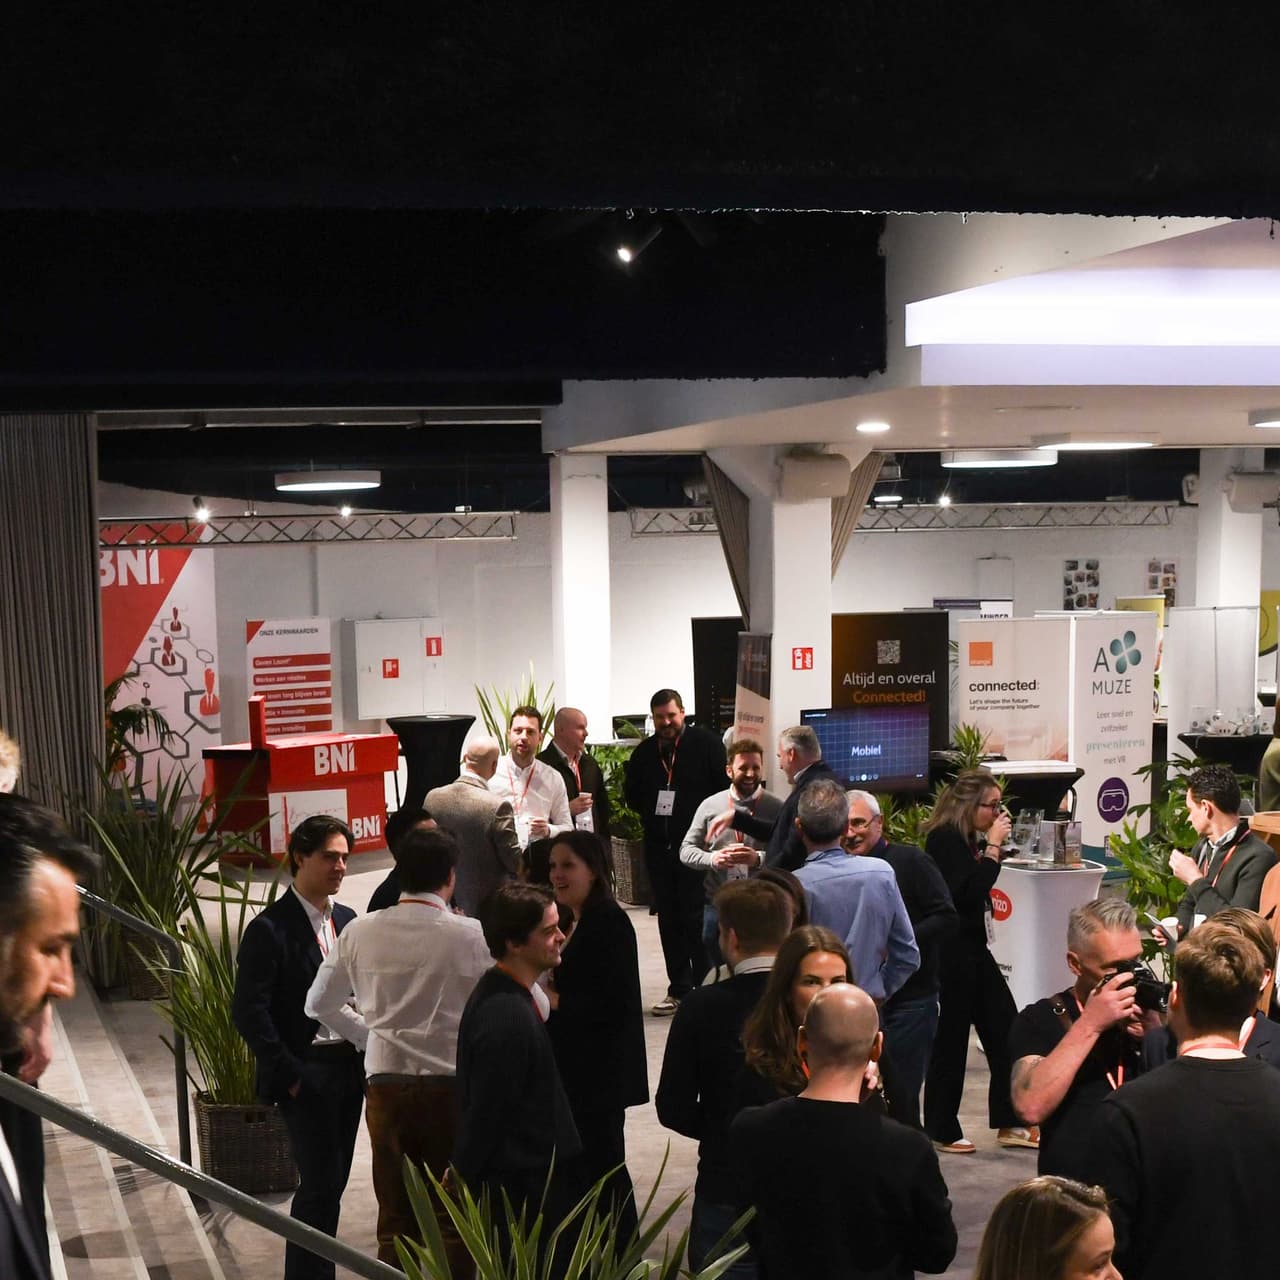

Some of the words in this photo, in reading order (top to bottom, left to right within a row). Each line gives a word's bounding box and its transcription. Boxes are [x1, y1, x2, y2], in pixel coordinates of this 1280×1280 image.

[1093, 647, 1110, 672] A
[843, 672, 875, 688] Altijd
[878, 675, 894, 684] en
[897, 670, 937, 684] overal
[1092, 679, 1132, 696] MUZE
[852, 690, 927, 703] Connected!
[314, 743, 356, 776] BNI
[851, 744, 882, 757] Mobiel
[351, 815, 381, 839] BNI
